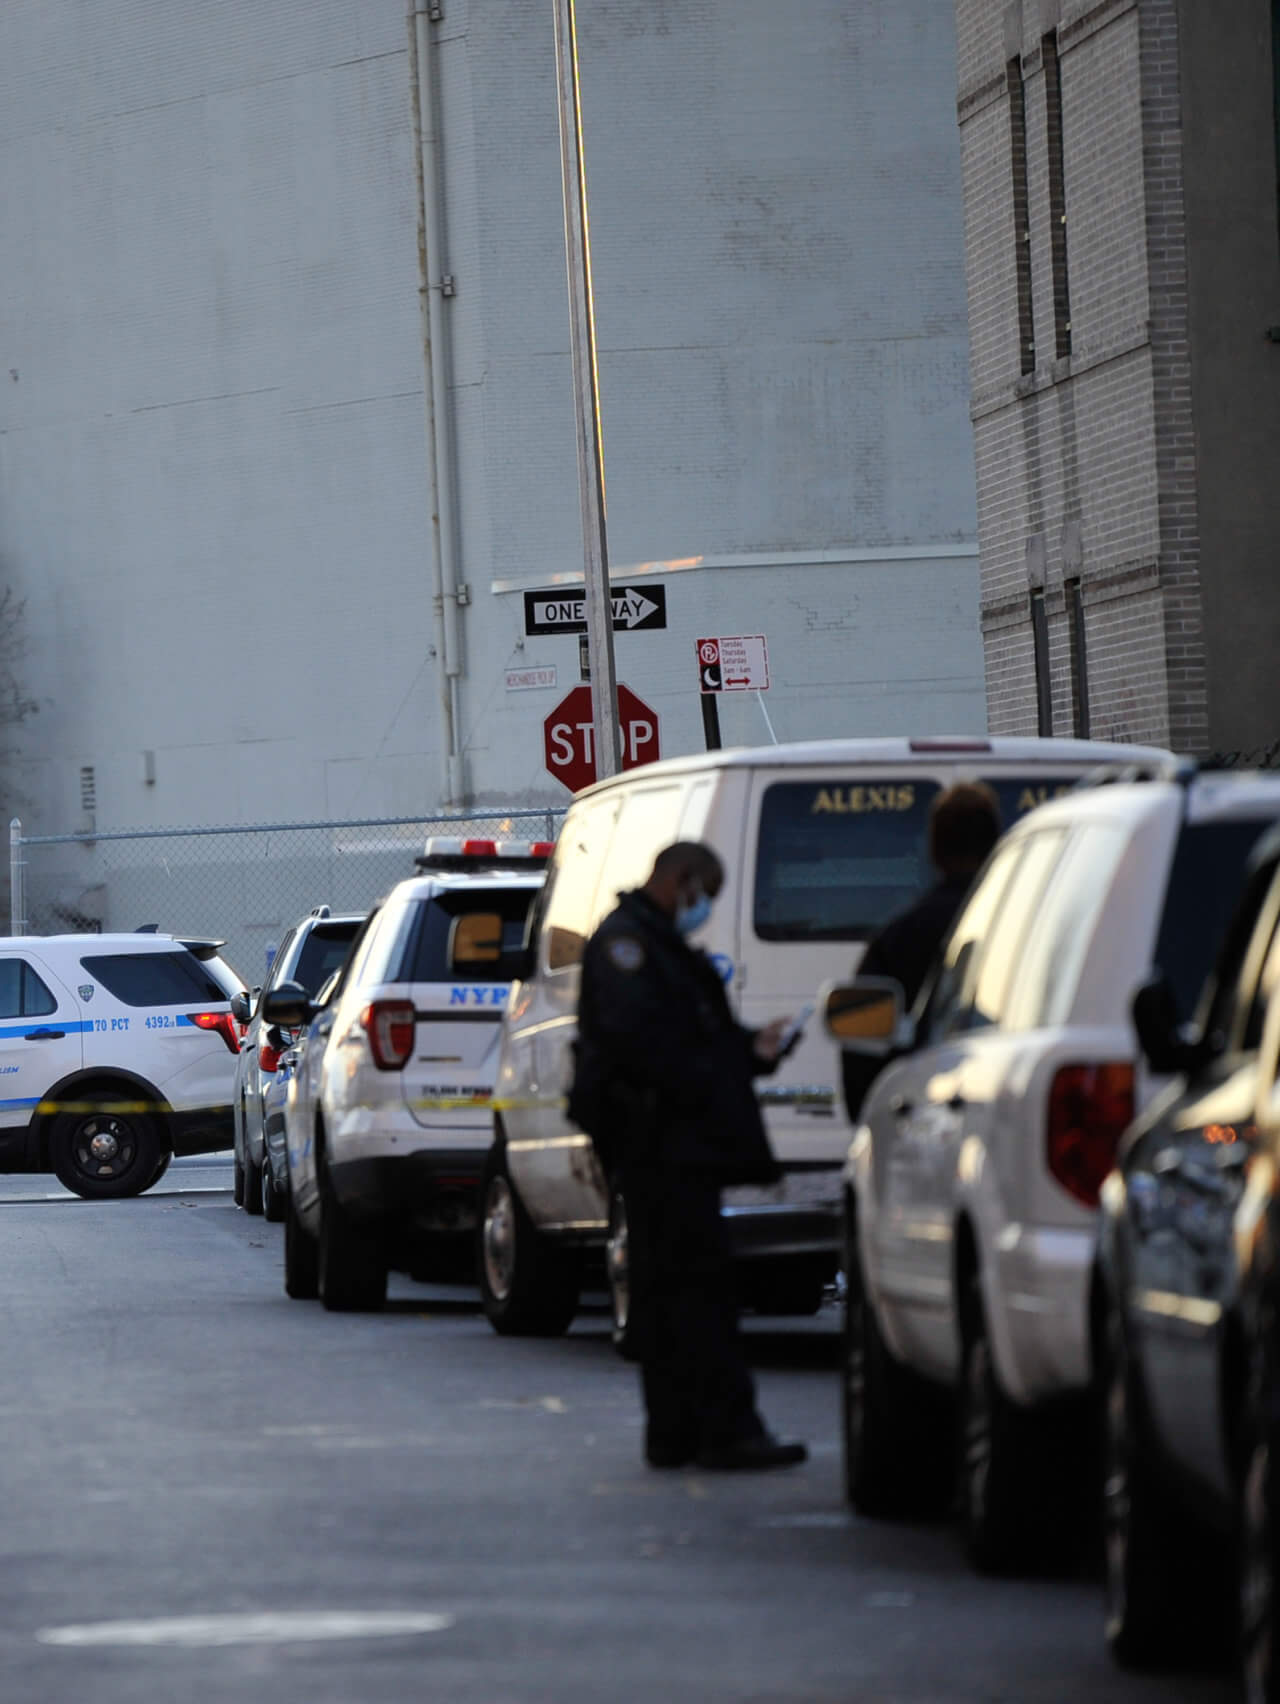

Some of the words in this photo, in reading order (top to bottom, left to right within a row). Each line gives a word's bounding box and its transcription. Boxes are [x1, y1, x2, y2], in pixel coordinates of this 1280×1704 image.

[545, 603, 584, 621] ONE
[550, 720, 653, 766] STP
[811, 785, 915, 813] ALEXIS
[449, 986, 509, 1005] NYP
[95, 1019, 107, 1031] 70
[111, 1017, 129, 1031] PCT
